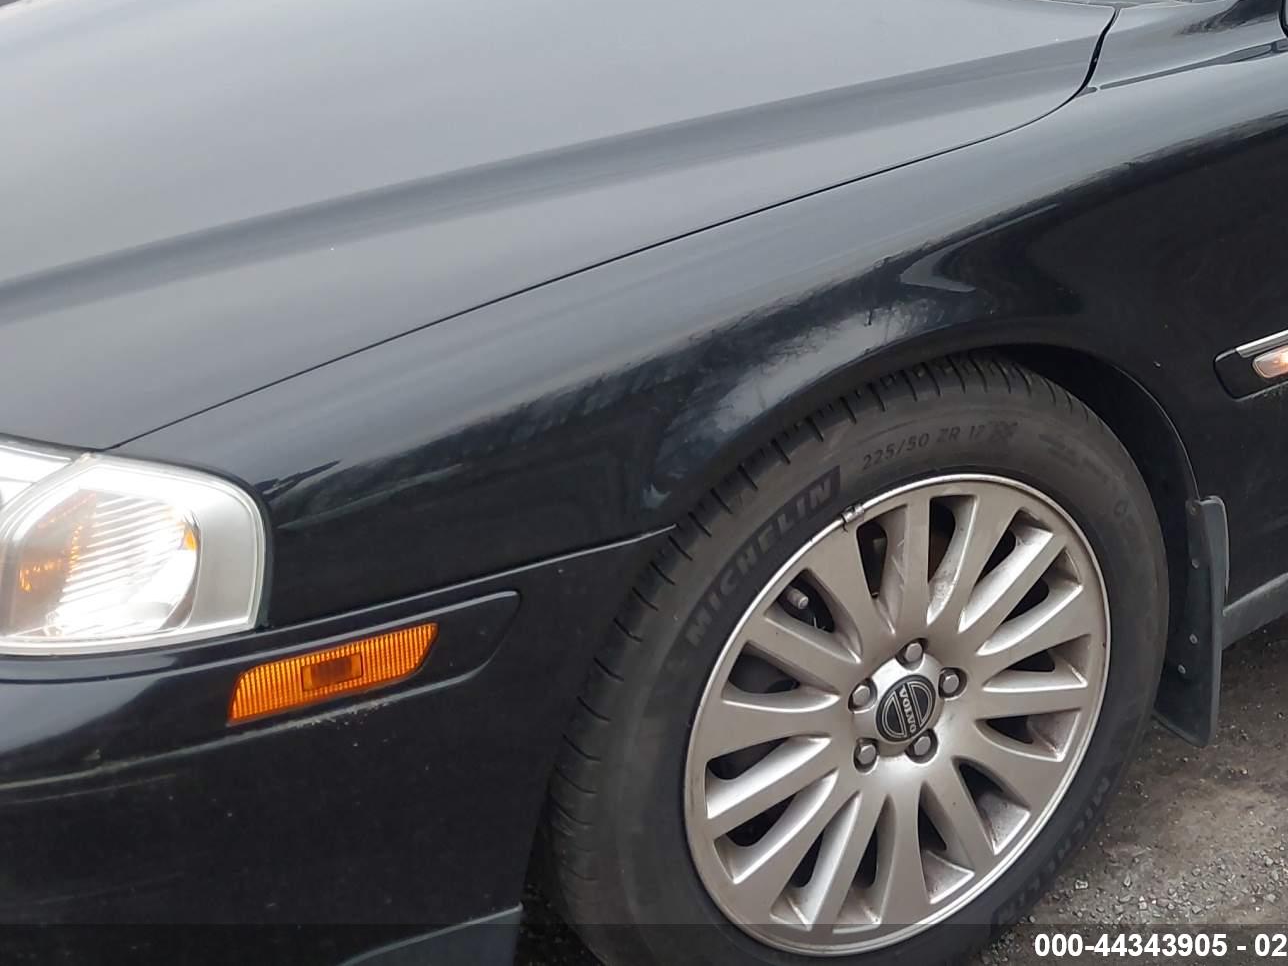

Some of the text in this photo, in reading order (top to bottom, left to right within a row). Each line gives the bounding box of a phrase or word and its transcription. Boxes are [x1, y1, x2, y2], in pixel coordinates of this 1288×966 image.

[862, 432, 930, 471] 225/50
[685, 477, 832, 647] MICHELIN
[898, 683, 917, 733] VOLVO
